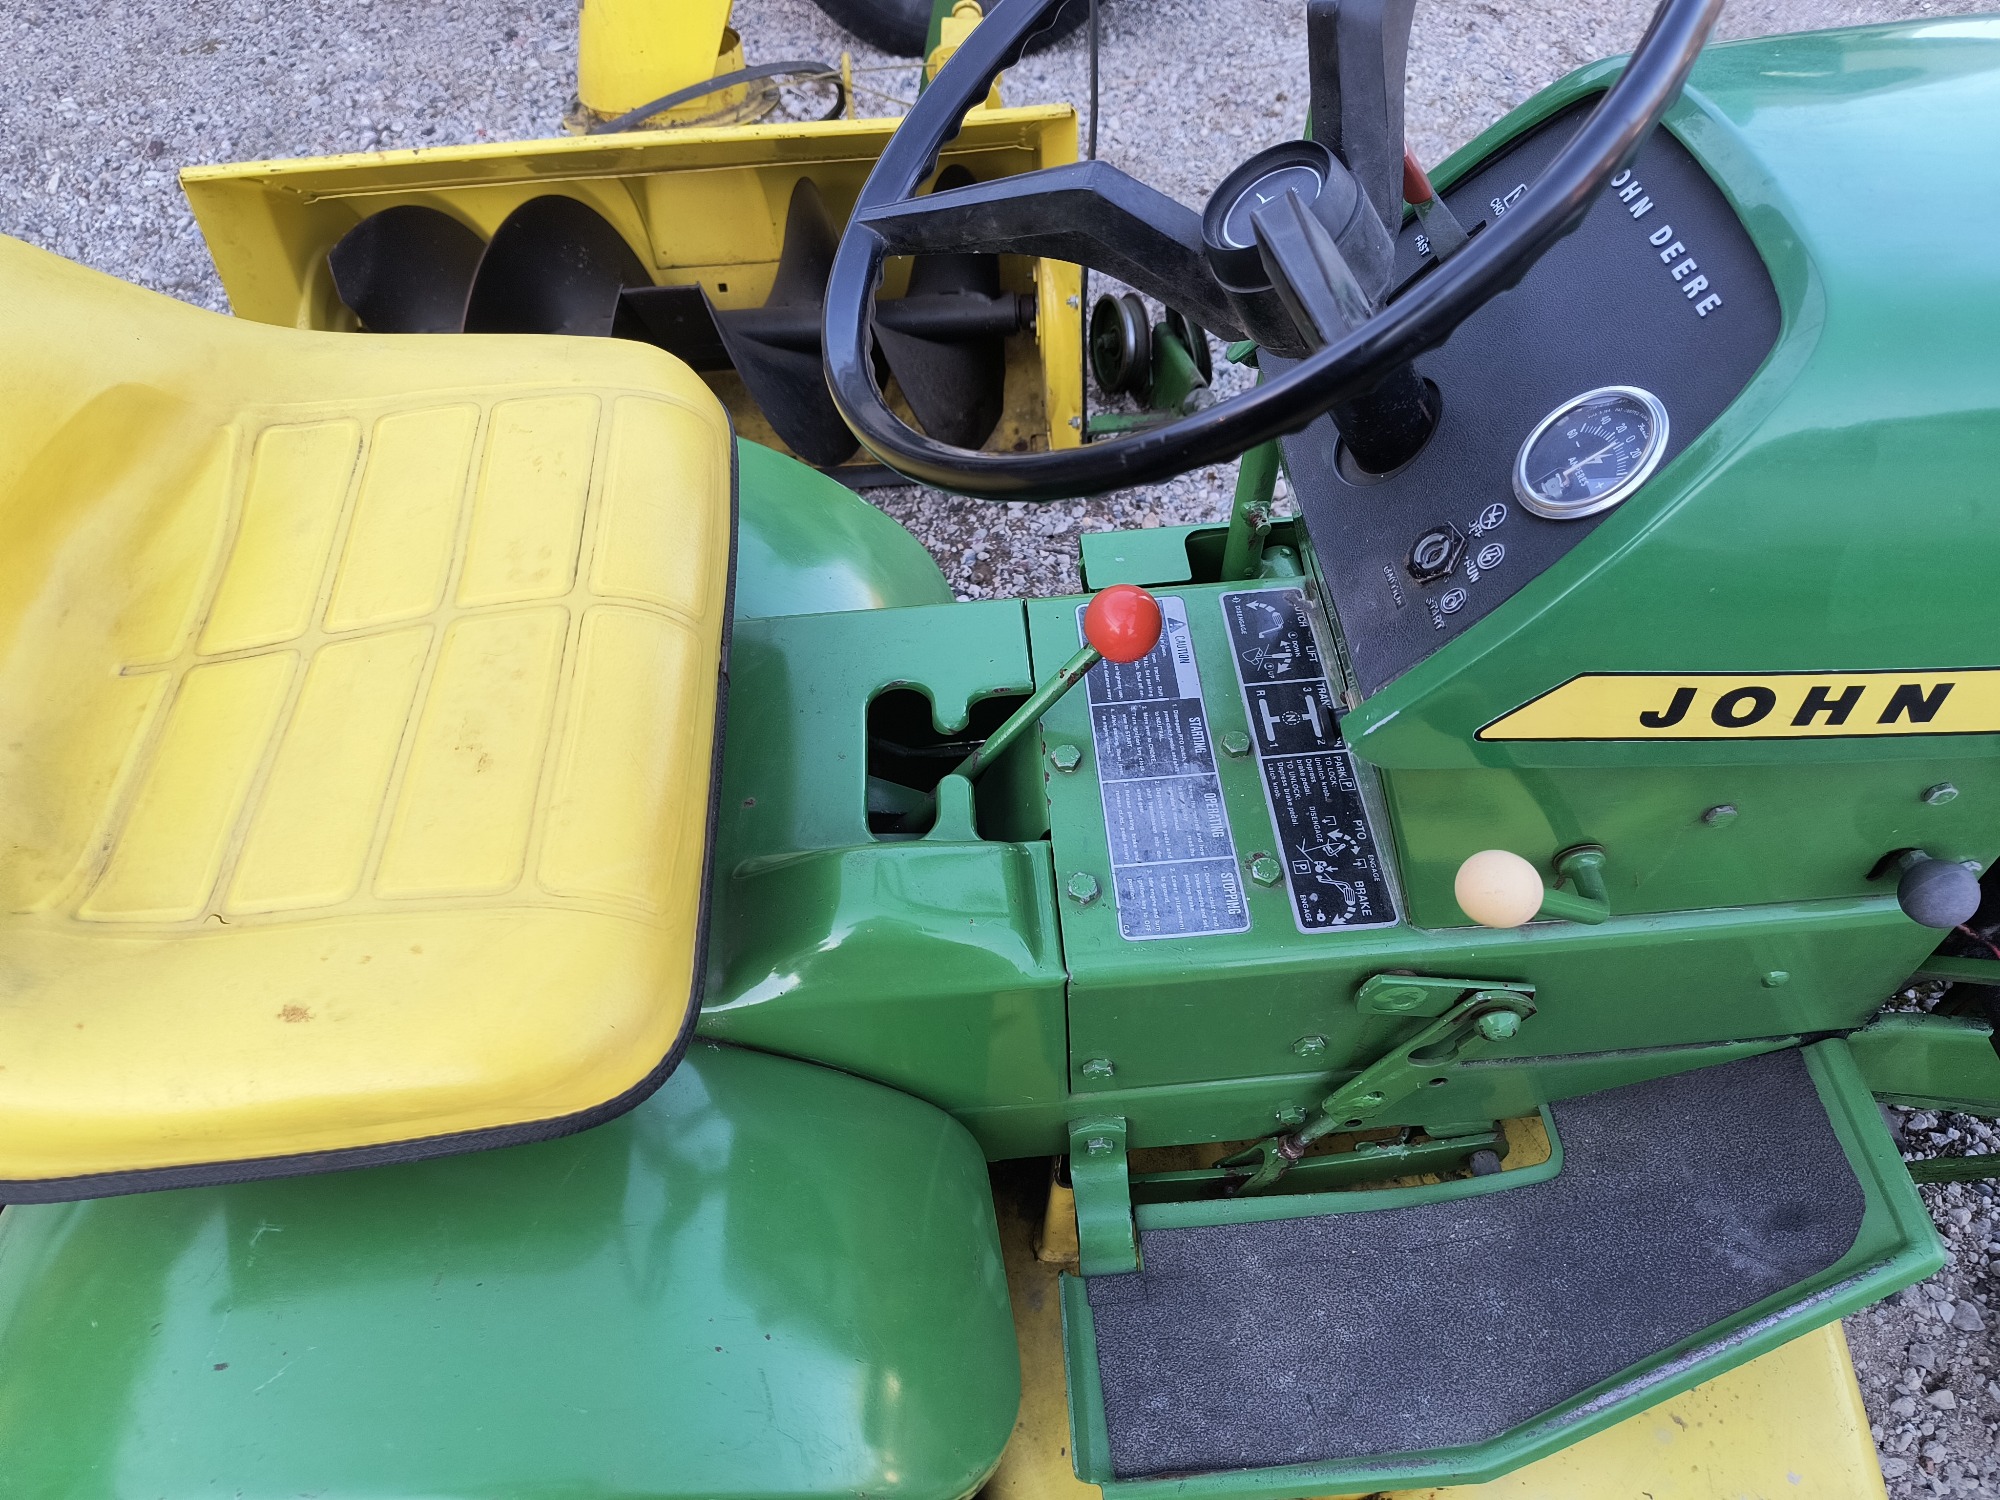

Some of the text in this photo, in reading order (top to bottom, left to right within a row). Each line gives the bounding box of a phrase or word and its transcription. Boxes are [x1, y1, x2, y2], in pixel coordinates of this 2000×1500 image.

[1414, 234, 1430, 256] FAST
[1611, 169, 1722, 317] OHN DEERE
[1600, 416, 1612, 424] 40
[1616, 422, 1628, 434] 20
[1566, 428, 1578, 438] 60
[1626, 434, 1636, 442] 0
[1630, 448, 1642, 460] 20
[1568, 456, 1589, 487] AMPERES
[1468, 520, 1484, 538] OFF
[1464, 558, 1481, 584] RUN
[1234, 605, 1247, 634] DISENGAGE
[1293, 602, 1308, 627] UTCH
[1426, 597, 1446, 630] START
[1174, 634, 1190, 664] CAUTION
[1291, 640, 1301, 657] DOWN
[1305, 645, 1318, 662] LIFT
[1267, 670, 1275, 678] UP
[1639, 683, 1955, 728] JOHN
[1285, 713, 1296, 722] N
[1188, 716, 1207, 753] STARTING
[1267, 762, 1277, 779] Latch
[1296, 759, 1307, 776] brake
[1313, 757, 1326, 780] Unlatch
[1324, 756, 1338, 787] TO LOCK:
[1332, 755, 1347, 778] PARK
[1285, 760, 1302, 800] TO UNLOCK:
[1154, 787, 1164, 809] Depress
[1275, 761, 1299, 826] Depress brake pedal.
[1126, 811, 1135, 830] parking
[1159, 810, 1167, 828] clutch
[1203, 792, 1224, 838] OPERATING
[1307, 805, 1324, 843] DISENGAGE
[1161, 829, 1170, 845] pedal
[1352, 819, 1367, 840] PTO
[1295, 863, 1307, 871] P
[1366, 853, 1380, 882] ENGAGE
[1170, 875, 1179, 893] Lower
[1182, 874, 1192, 895] parking
[1220, 871, 1241, 915] STOPPING
[1299, 894, 1313, 922] ENGAGE
[1353, 880, 1372, 916] BRAKE
[1174, 896, 1185, 929] attachment
